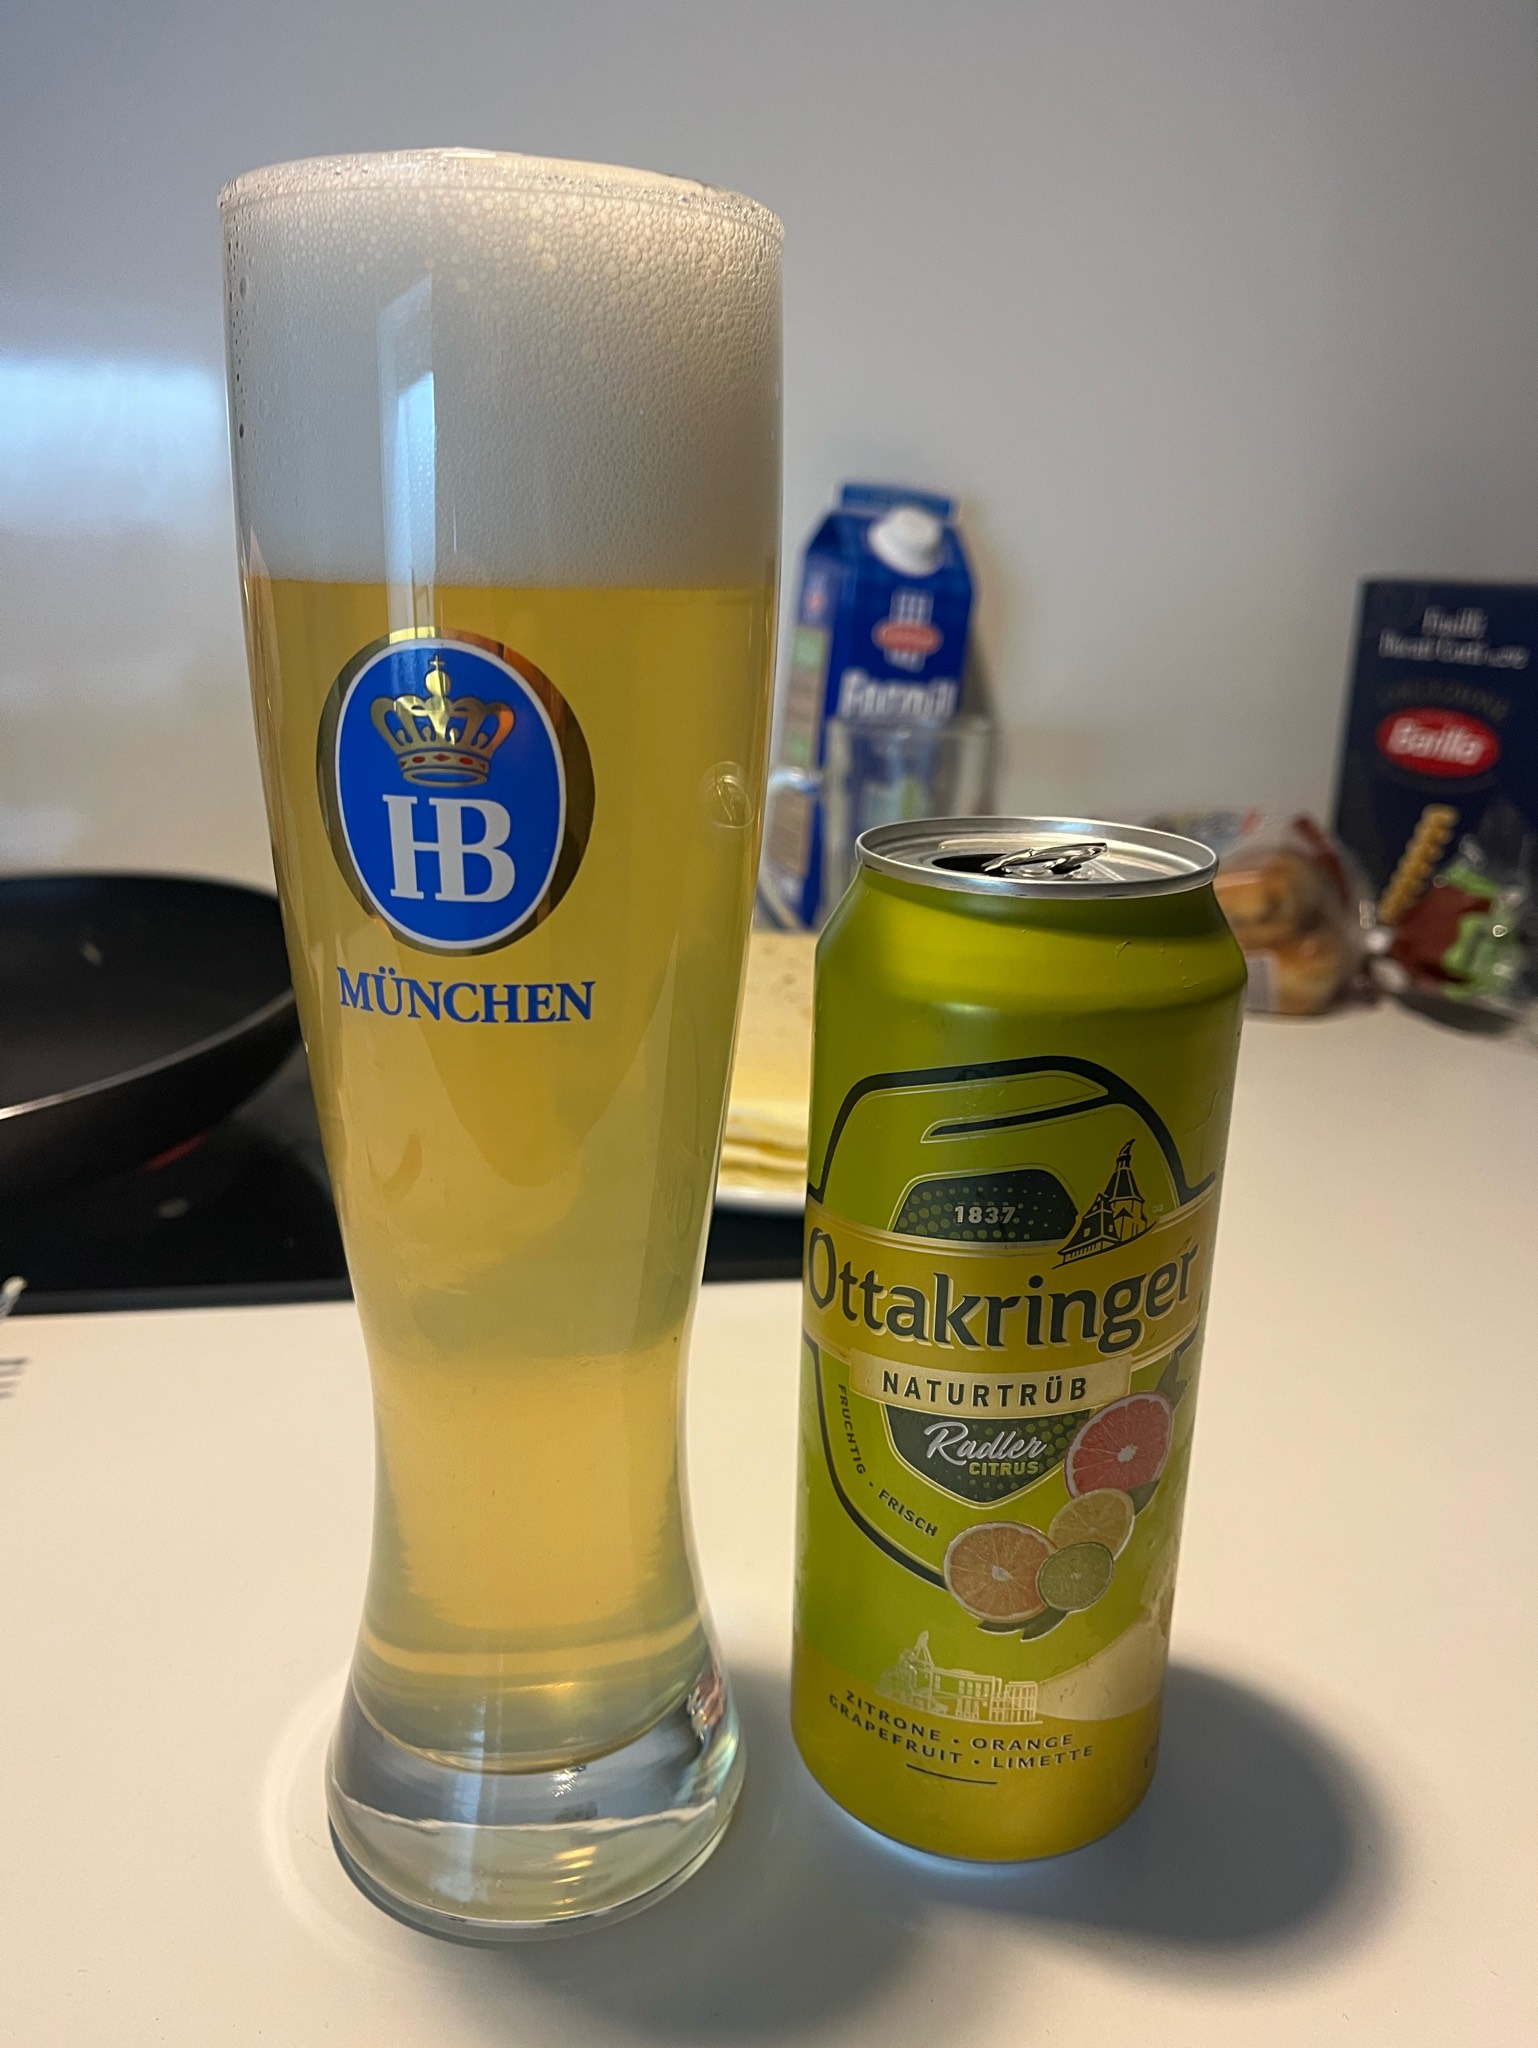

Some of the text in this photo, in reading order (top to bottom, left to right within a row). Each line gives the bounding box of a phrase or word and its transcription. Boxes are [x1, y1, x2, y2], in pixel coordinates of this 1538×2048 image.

[382, 795, 516, 903] HB
[336, 965, 596, 1024] MÜNCHEN
[954, 1205, 1015, 1224] 1837
[809, 1228, 1199, 1353] Ottakringer
[882, 1370, 1088, 1408] NATURTRÜB
[838, 1384, 939, 1537] FRUCHTIG FRISCH
[924, 1421, 1047, 1466] Radler
[969, 1461, 1040, 1476] CITRUS
[829, 1693, 1093, 1769] GRAPEFRUIT LIMETTE
[845, 1690, 1074, 1751] ZITRONE ORANGE
